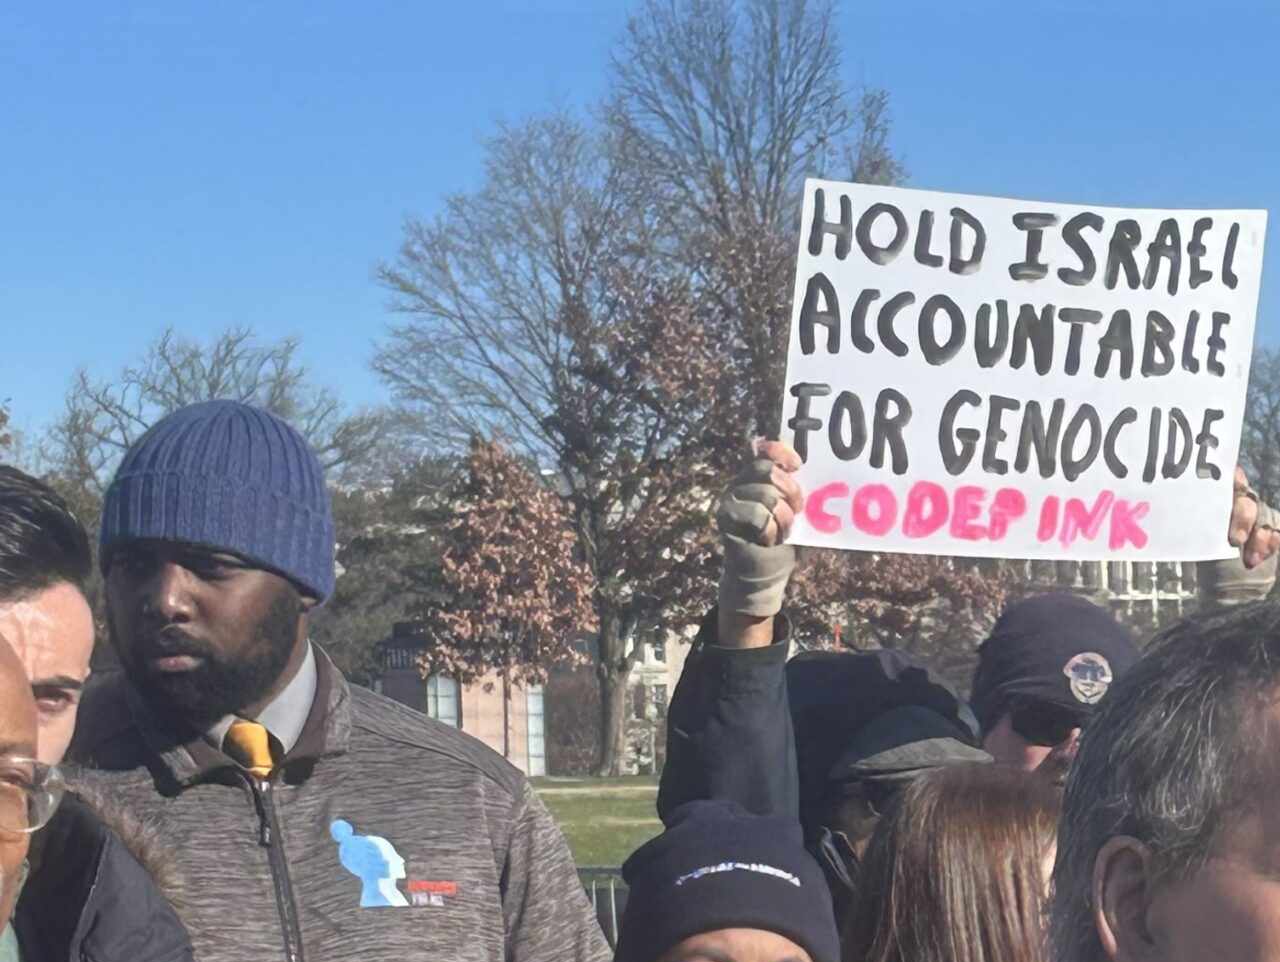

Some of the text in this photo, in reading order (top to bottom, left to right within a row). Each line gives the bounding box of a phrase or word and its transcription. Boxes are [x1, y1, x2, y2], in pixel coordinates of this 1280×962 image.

[807, 188, 1240, 296] HOLD ISRAEL
[800, 272, 1231, 380] ACCOUNTABLE
[788, 382, 1225, 483] FOR GENOCIDE
